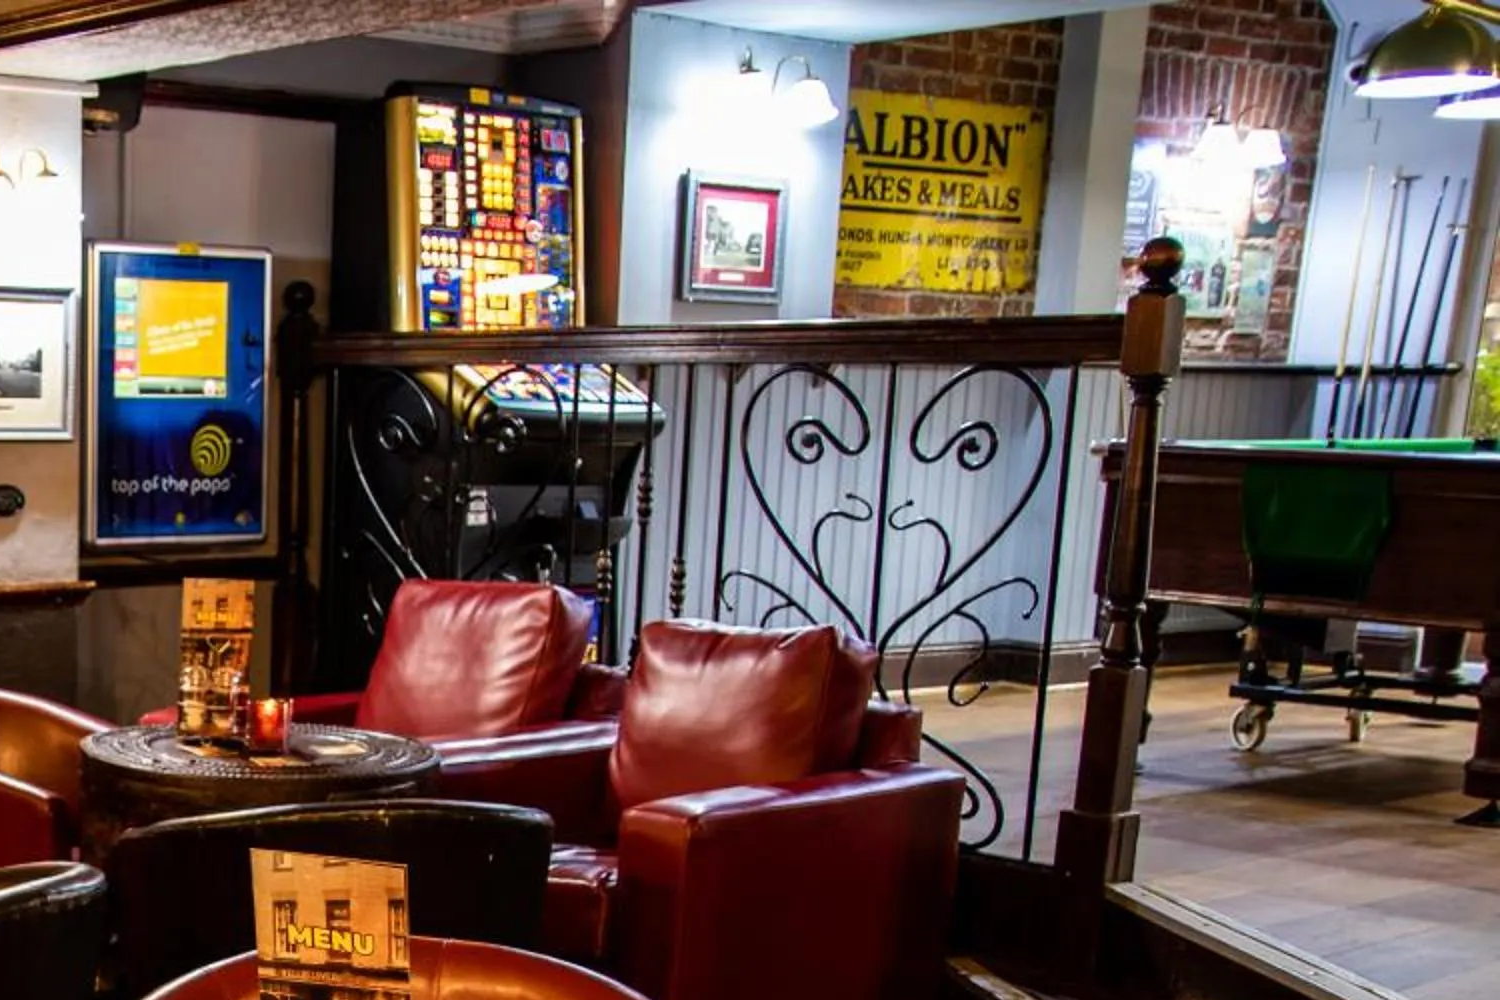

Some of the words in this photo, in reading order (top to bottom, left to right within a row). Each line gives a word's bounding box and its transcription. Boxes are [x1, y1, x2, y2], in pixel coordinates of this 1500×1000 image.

[917, 179, 933, 205] &
[938, 181, 1022, 212] MEALS
[111, 476, 140, 496] top
[142, 474, 159, 493] of
[161, 474, 189, 493] the
[190, 476, 231, 497] pops
[287, 923, 375, 957] MENU
